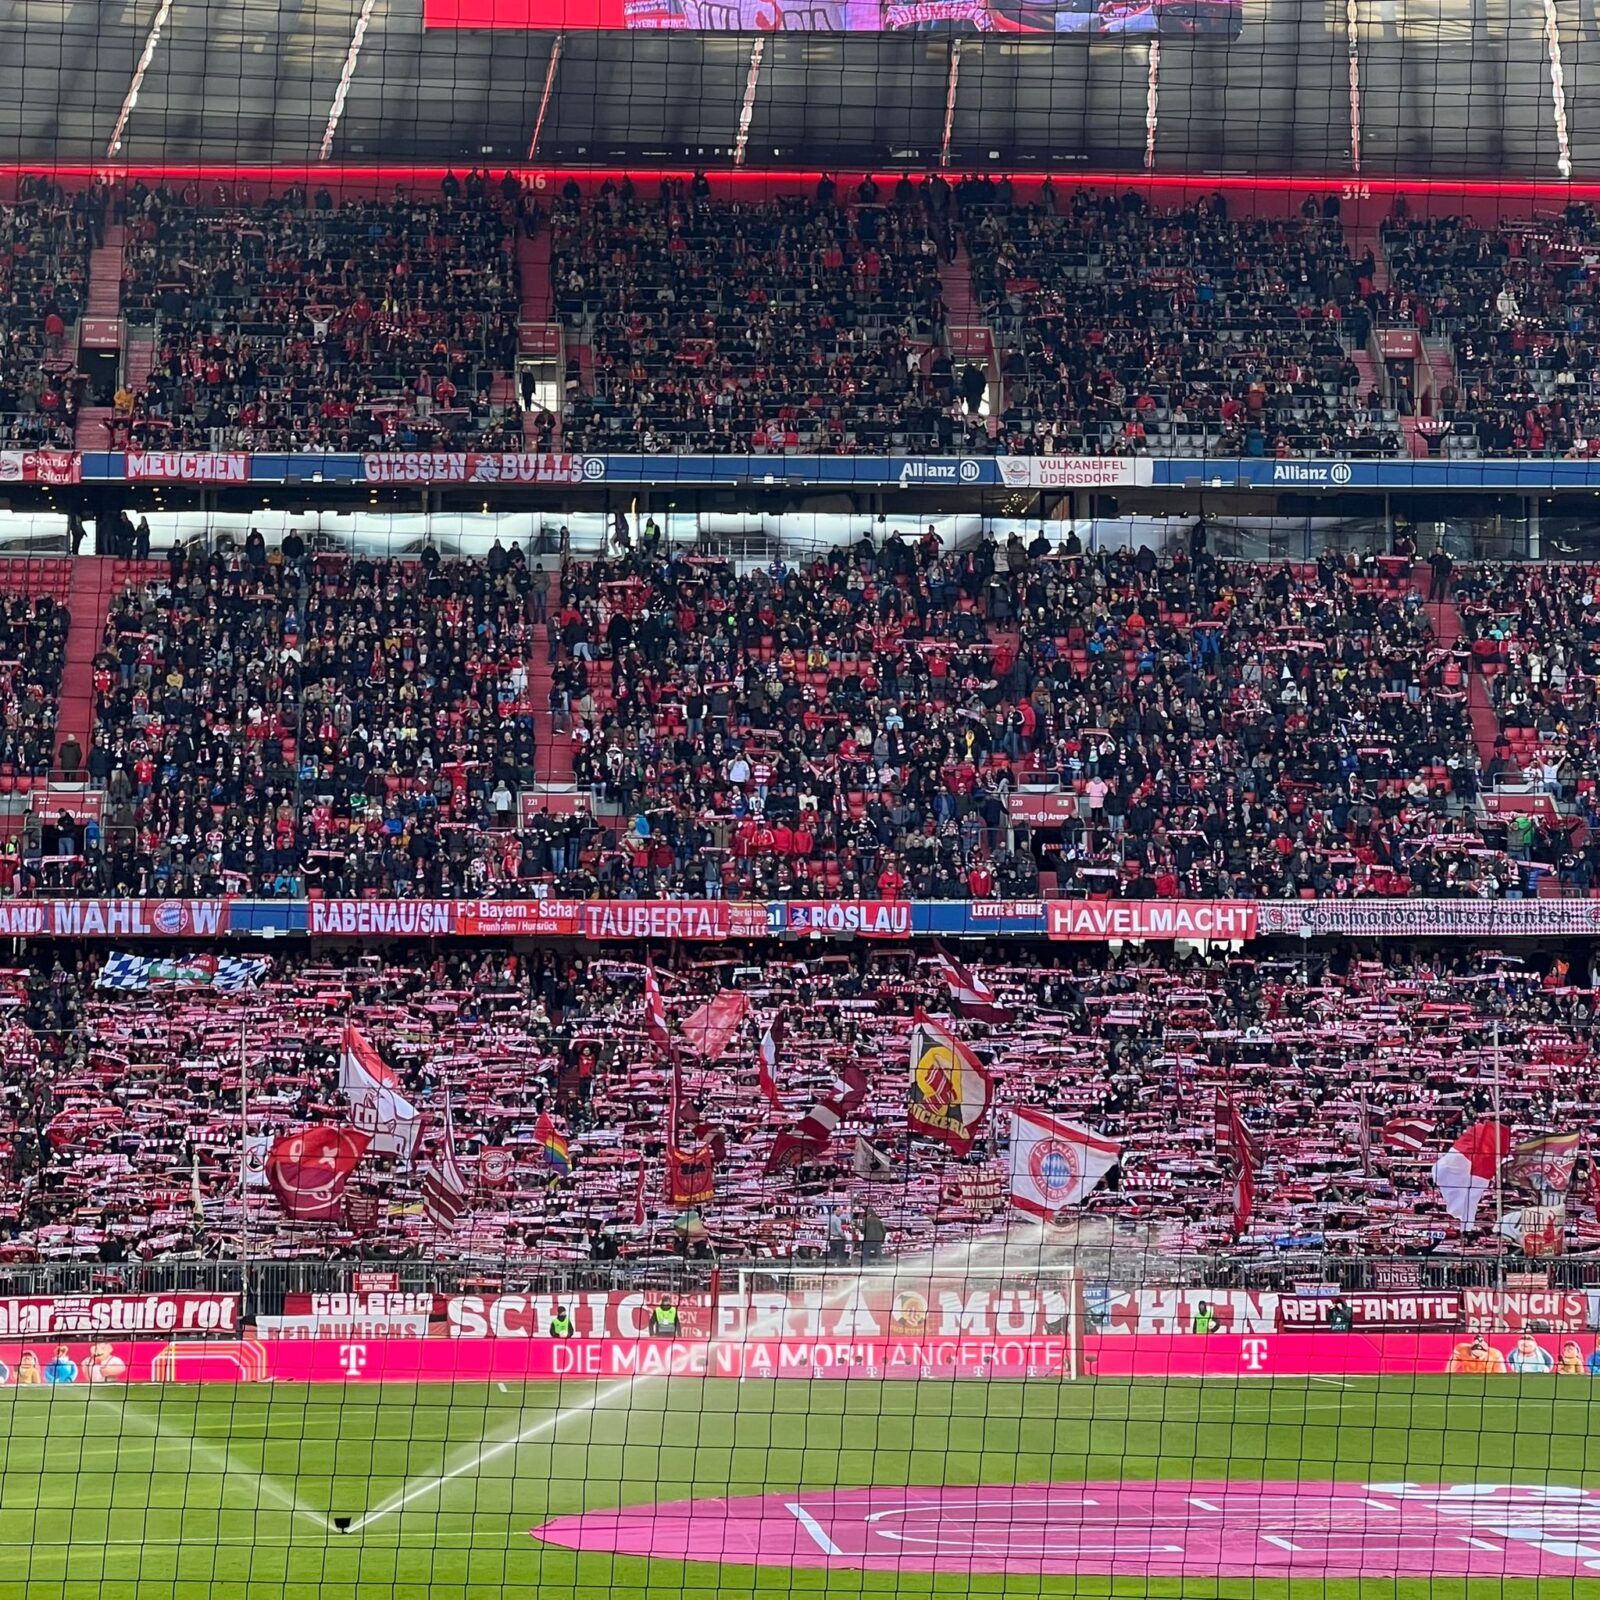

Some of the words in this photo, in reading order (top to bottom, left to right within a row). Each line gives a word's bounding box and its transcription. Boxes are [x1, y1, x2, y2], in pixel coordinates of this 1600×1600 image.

[518, 173, 546, 190] 316
[1342, 184, 1371, 200] 314
[127, 454, 245, 480] MEUCHEN
[364, 453, 466, 481] GIESSEN
[501, 454, 583, 481] BULLS
[901, 462, 956, 478] Allianz
[1039, 460, 1128, 471] VULKANEIFEL
[1273, 464, 1328, 480] Allianz
[1039, 472, 1120, 485] ÜDERSDORF
[1011, 799, 1024, 807] 220
[38, 810, 60, 819] Allian
[1048, 813, 1069, 821] Arena
[457, 904, 475, 917] FC
[479, 903, 526, 921] Bayern
[972, 904, 1005, 916] LETZTE
[587, 906, 728, 937] TAUBERTAL
[811, 904, 907, 933] RÖSLAU
[1377, 1272, 1420, 1283] JUNGS!
[182, 1297, 235, 1329] rot
[340, 1345, 367, 1376] T
[553, 1344, 600, 1373] DIE
[612, 1342, 770, 1374] MAGENTA
[1242, 1339, 1268, 1369] T
